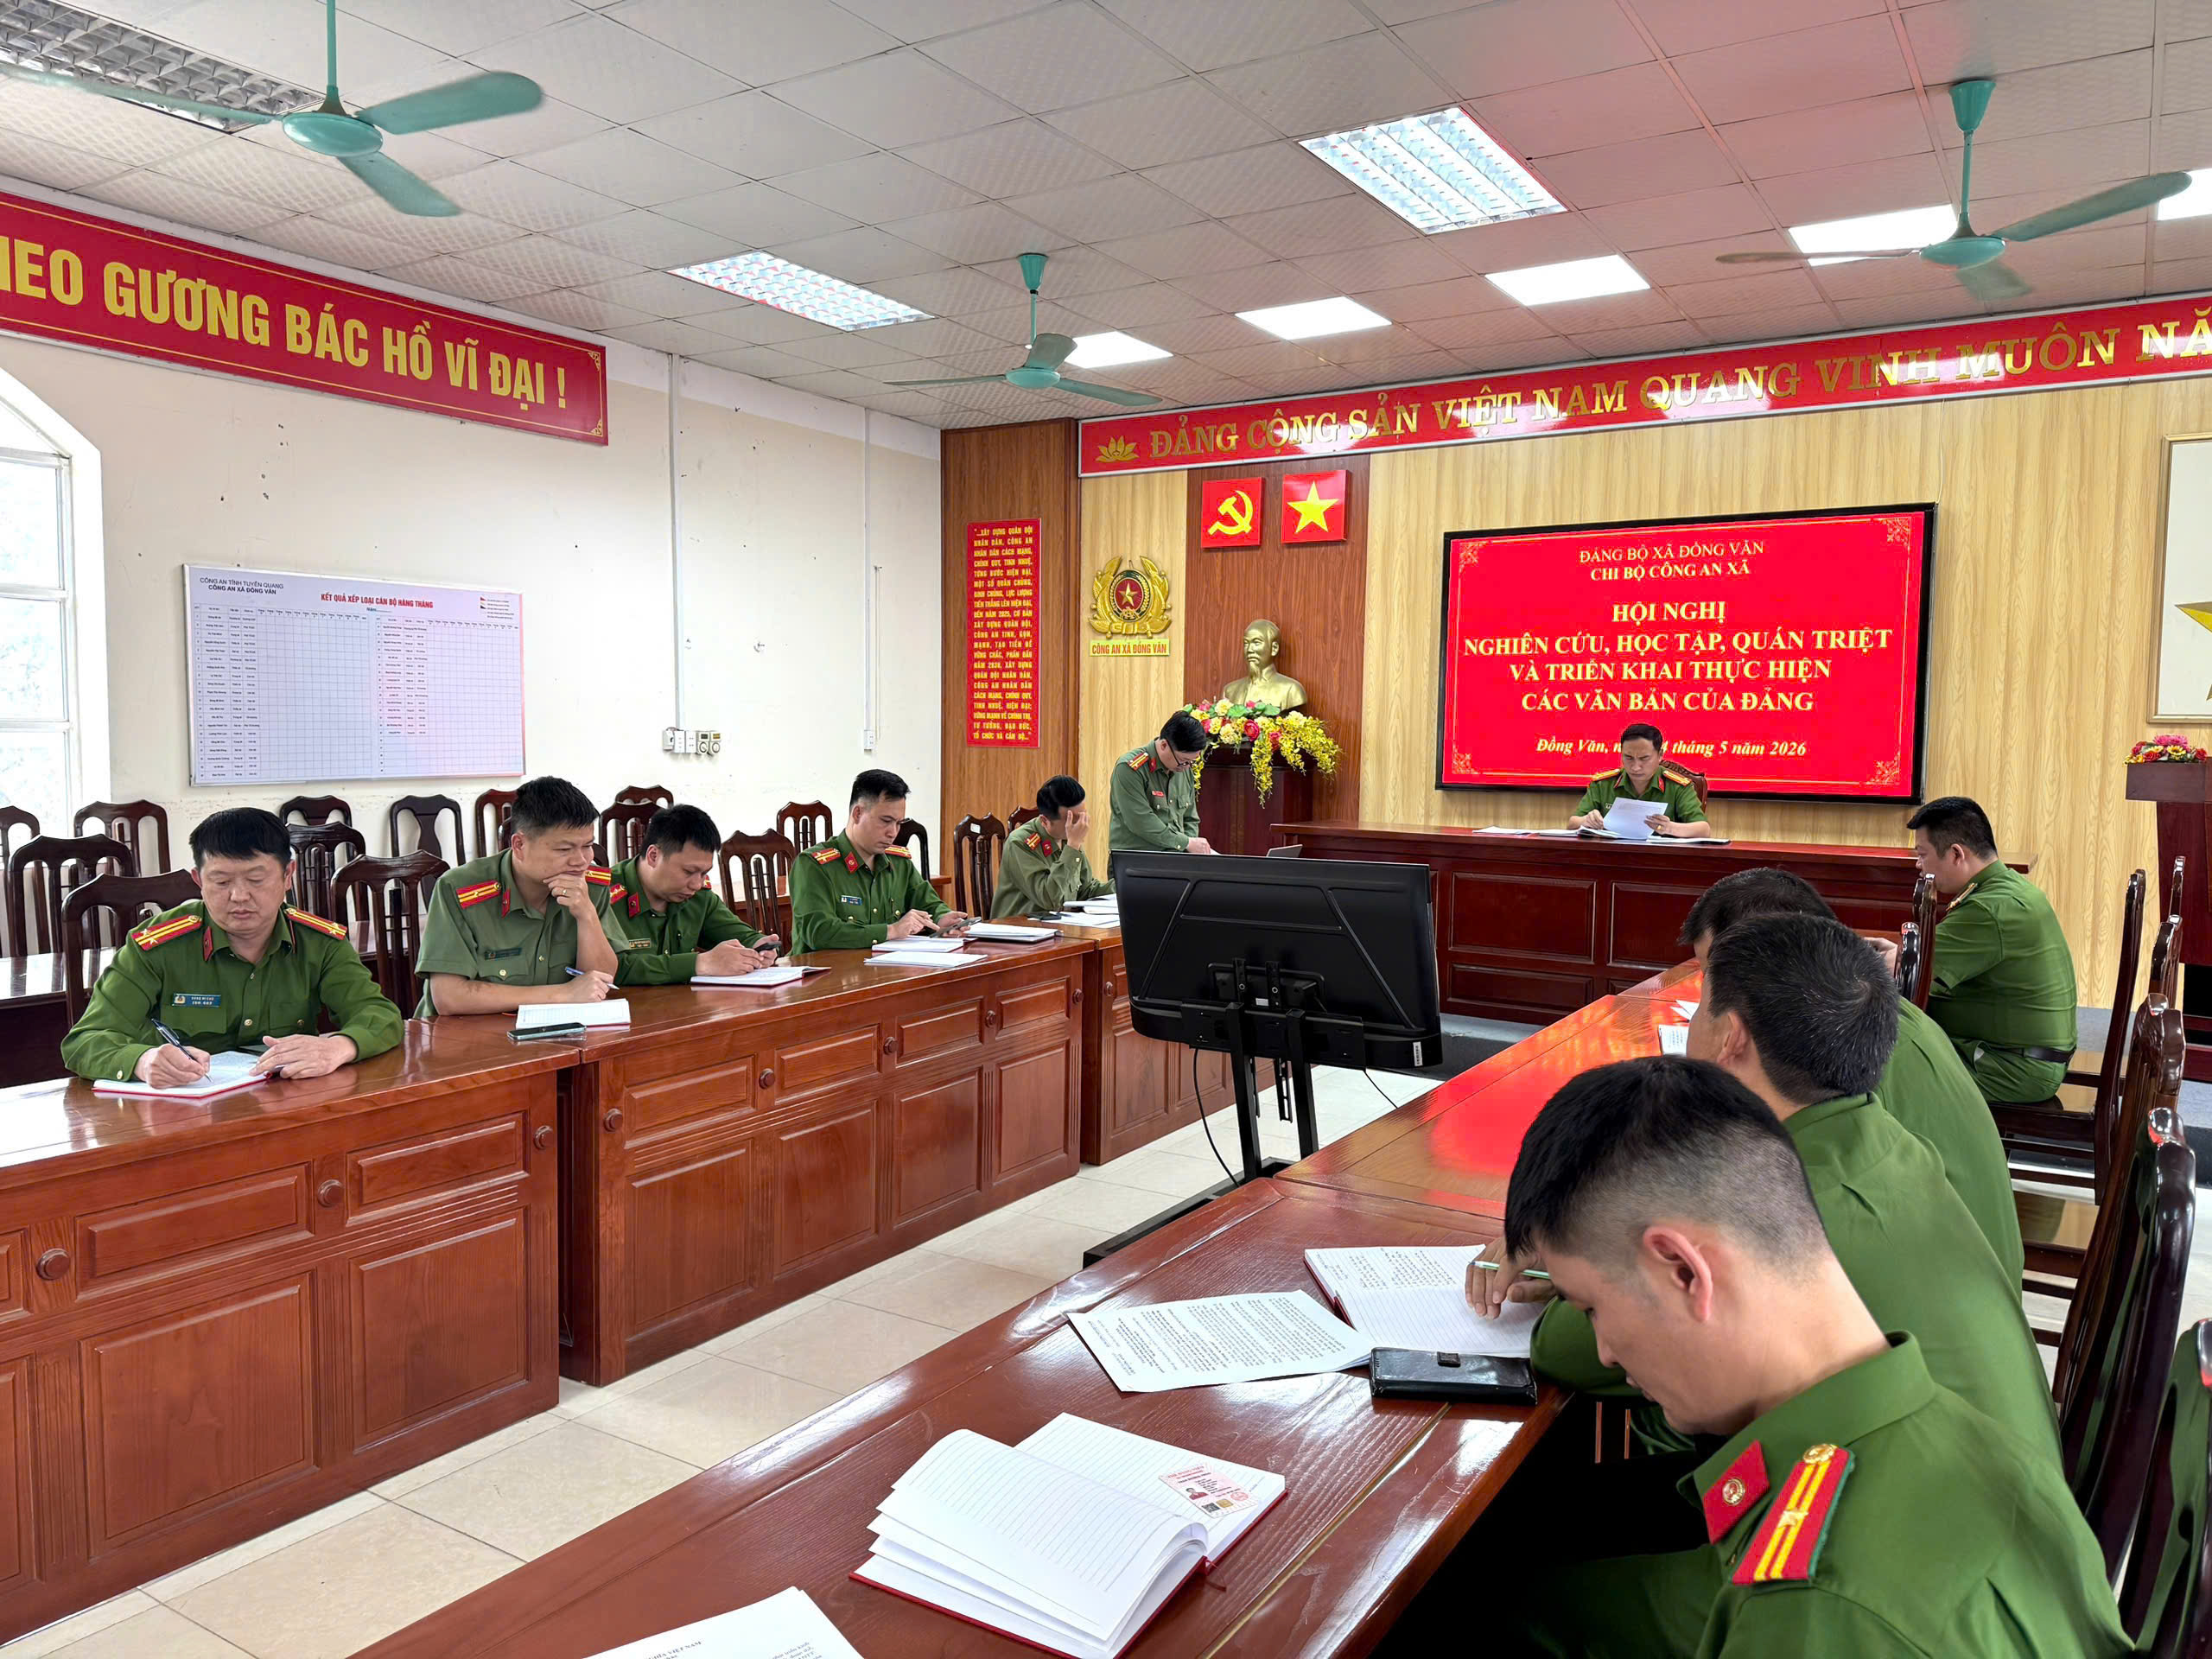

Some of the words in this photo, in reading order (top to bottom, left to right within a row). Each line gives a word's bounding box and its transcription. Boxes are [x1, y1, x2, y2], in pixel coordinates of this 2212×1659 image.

[104, 261, 270, 346] GƯƠNG
[285, 302, 369, 366] BÁC
[383, 320, 432, 380] HỒ
[444, 337, 479, 391] VĨ
[489, 352, 545, 410] ĐẠI
[1150, 415, 1238, 458] ĐẢNG
[1246, 408, 1338, 454] CỘNG
[1348, 392, 1421, 440] SẢN
[1431, 385, 1521, 435] VIỆT
[1532, 380, 1628, 421] NAM
[1640, 362, 1802, 411] QUANG
[1816, 347, 1942, 391] VINH
[1955, 321, 2120, 380] MUÔN
[1628, 544, 1649, 562] BỘ
[1652, 543, 1675, 559] XÃ
[1680, 542, 1725, 558] ĐỒNG
[1729, 540, 1764, 555] VĂN
[1591, 567, 1618, 581] CHI
[1624, 564, 1645, 581] BỘ
[1649, 562, 1695, 577] CÔNG
[1699, 563, 1722, 576] AN
[1727, 559, 1750, 575] XÃ
[321, 592, 332, 601] KẾT
[334, 593, 346, 602] QUẢ
[347, 594, 359, 603] XẾP
[361, 596, 373, 605] LOẠI
[389, 598, 397, 607] BỘ
[1612, 601, 1656, 626] HỘI
[1663, 601, 1726, 624] NGHỊ
[1092, 643, 1109, 655] CÔNG
[1111, 645, 1121, 653] AN
[1122, 643, 1131, 653] XÃ
[1465, 632, 1548, 655] NGHIÊN
[1555, 632, 1610, 655] CỨU,
[1618, 633, 1669, 656] HỌC
[1675, 630, 1726, 655] TẬP,
[1732, 626, 1804, 653] QUÁN
[1811, 626, 1892, 653] TRIỆT
[1510, 660, 1540, 681] VÀ
[1545, 658, 1615, 680] TRIỂN
[1621, 662, 1682, 679] KHAI
[1690, 658, 1761, 683] THỰC
[1769, 657, 1831, 683] HIỆN
[1522, 689, 1569, 710] CÁC
[1574, 690, 1621, 710] VĂN
[1628, 687, 1676, 710] BẢN
[1683, 687, 1735, 710] CỦA
[1740, 686, 1813, 710] ĐẢNG
[1536, 739, 1573, 753] Đồng
[1578, 739, 1608, 753] Văn,
[1673, 741, 1714, 757] tháng
[1719, 741, 1728, 754] 5
[1732, 741, 1764, 755] năm
[1770, 741, 1807, 755] 2026
